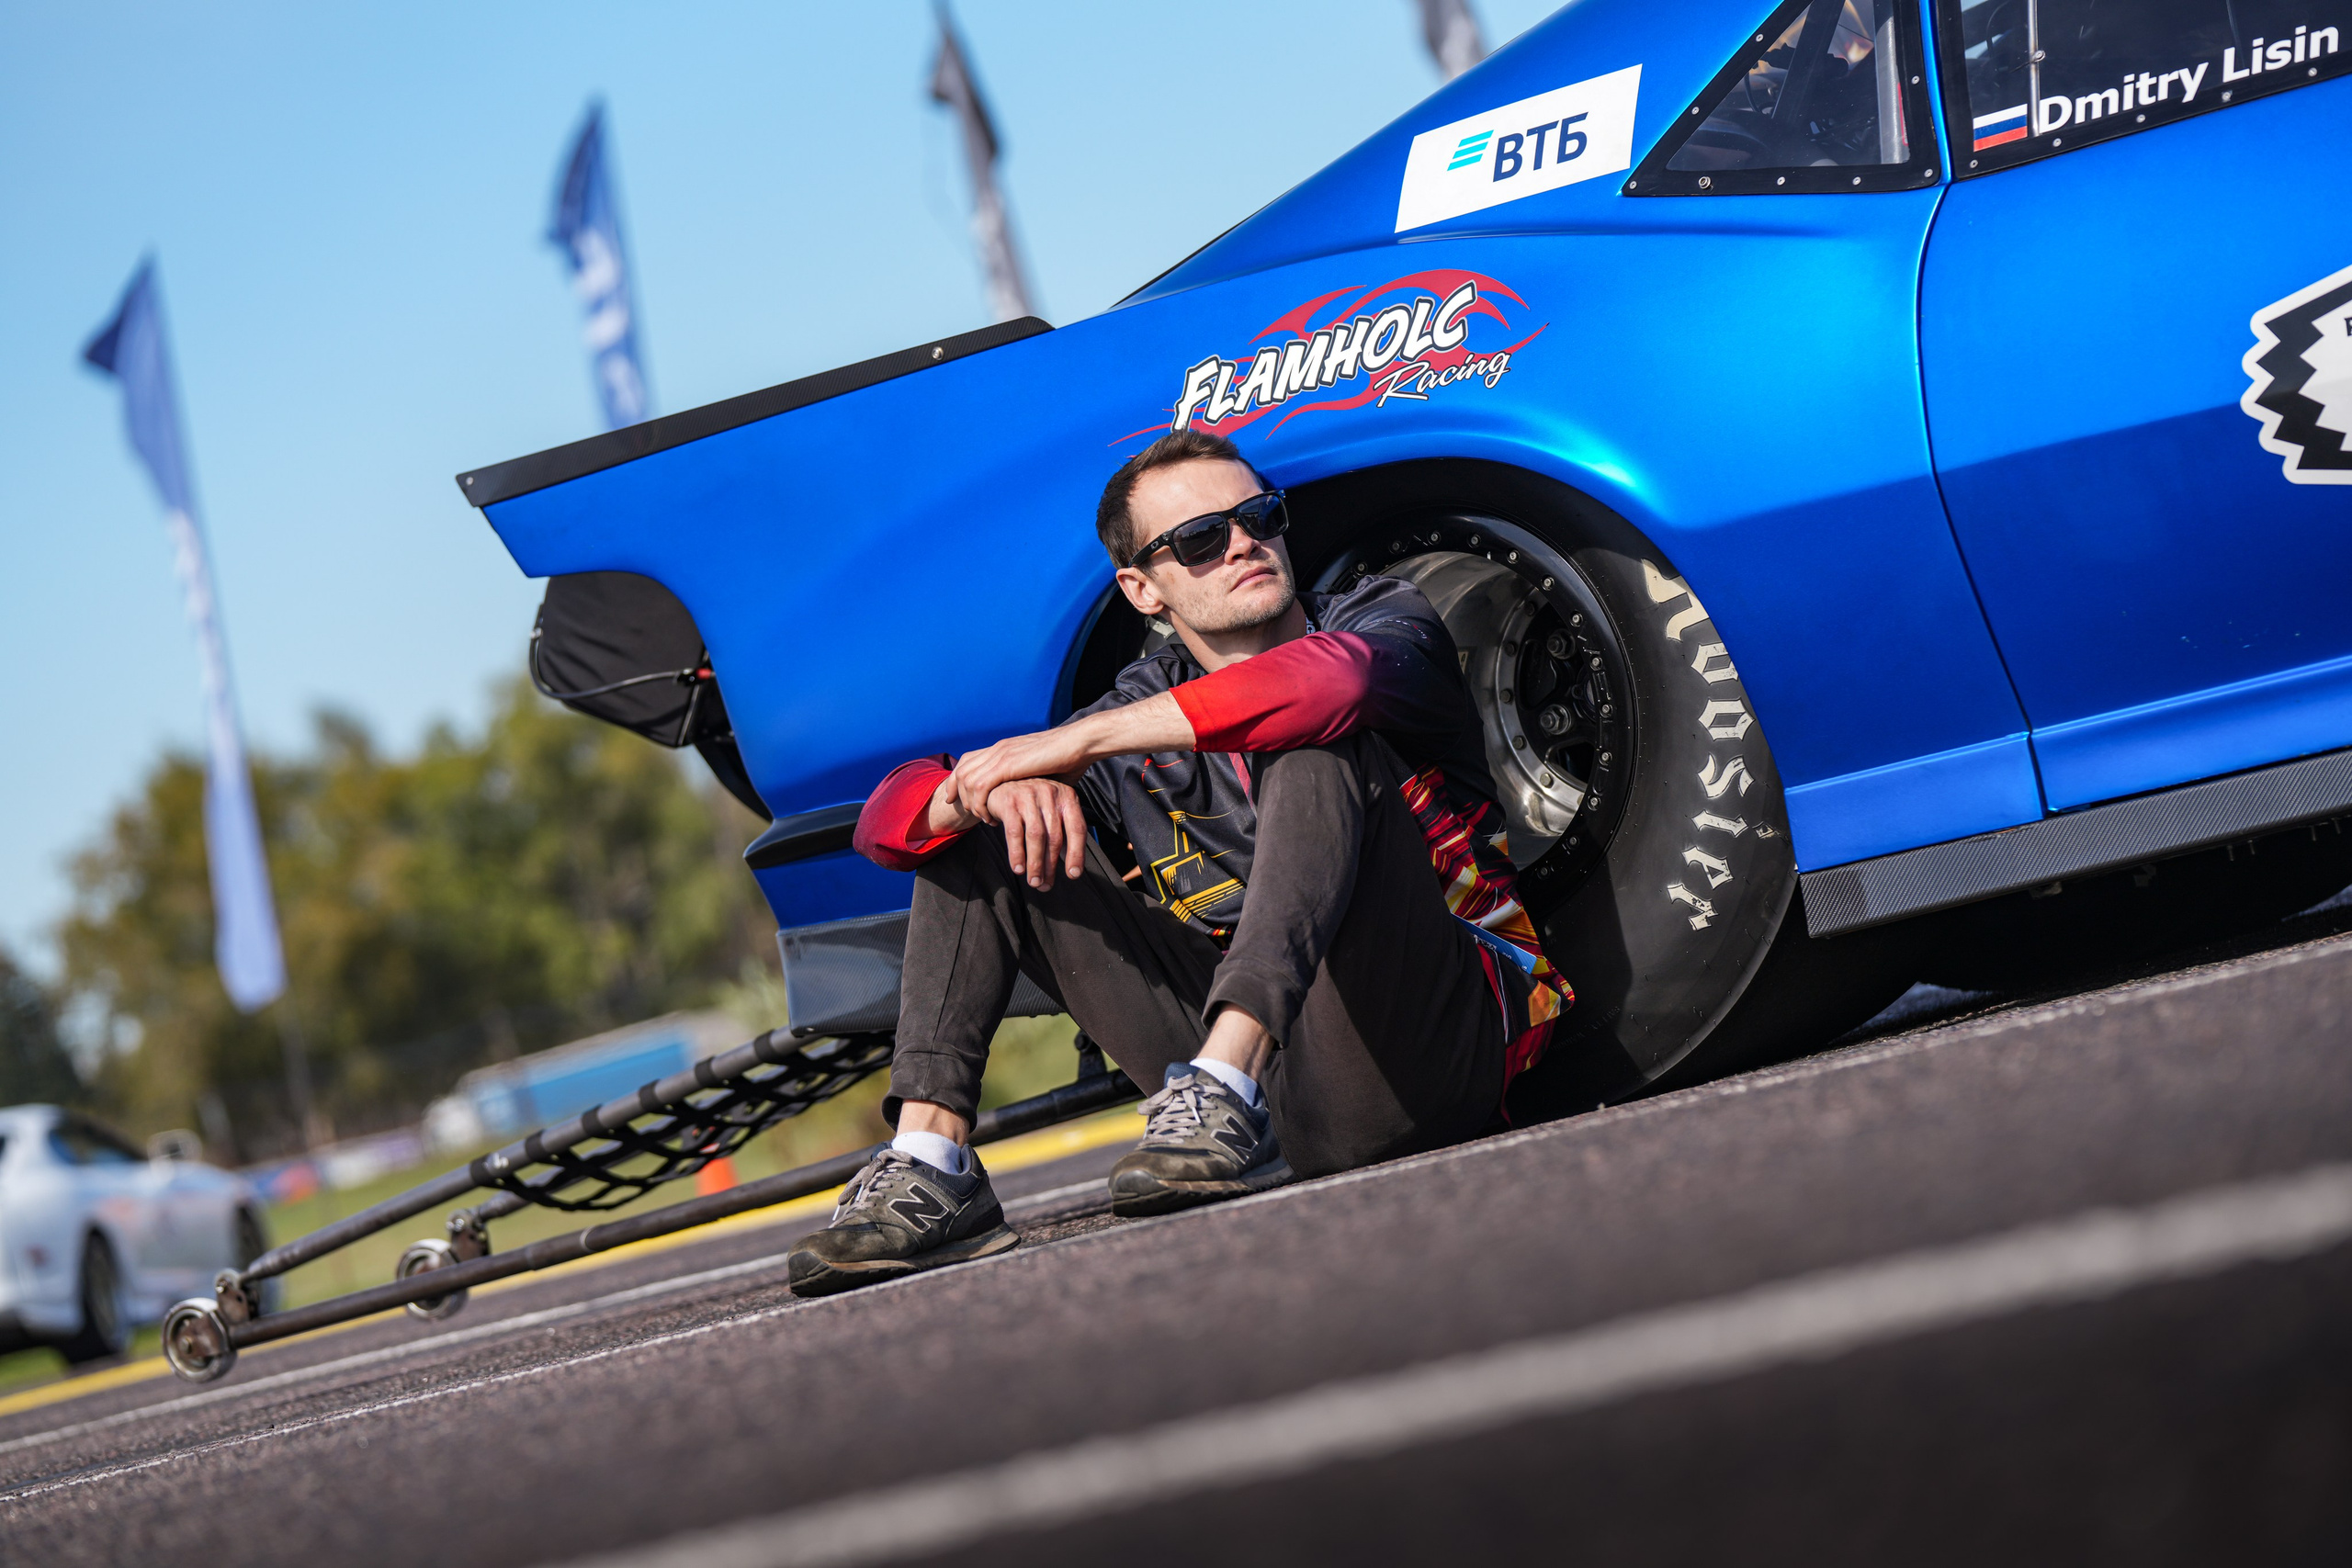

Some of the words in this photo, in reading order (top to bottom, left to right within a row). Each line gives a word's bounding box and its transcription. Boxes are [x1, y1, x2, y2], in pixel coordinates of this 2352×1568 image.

[2039, 62, 2209, 134] Dmitry
[2222, 25, 2339, 84] Lisin
[1493, 111, 1589, 183] ВТБ
[1170, 279, 1477, 433] FLAMHOLC
[1374, 351, 1512, 409] Racing
[1210, 1112, 1259, 1165] N
[887, 1181, 950, 1234] N
